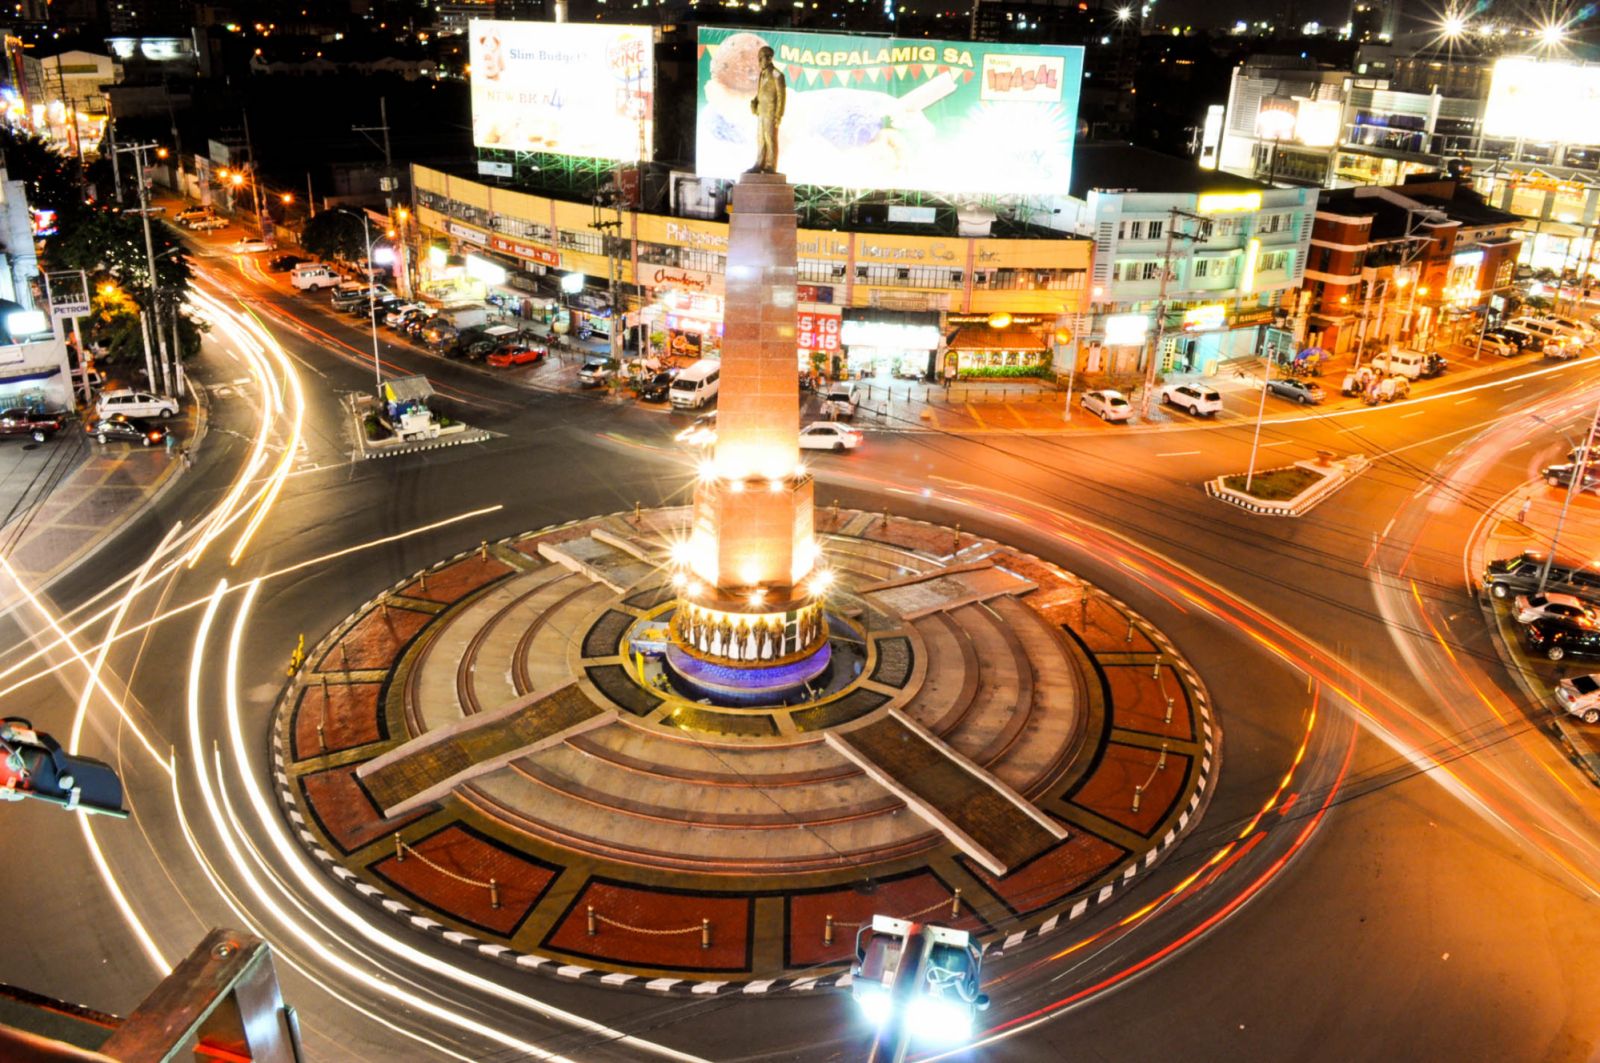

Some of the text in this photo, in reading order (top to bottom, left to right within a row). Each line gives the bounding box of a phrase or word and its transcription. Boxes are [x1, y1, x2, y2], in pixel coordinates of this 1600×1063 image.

[509, 48, 535, 60] Slim
[780, 44, 973, 67] MAGPALAMIG SA
[860, 239, 925, 260] Insurance
[54, 305, 89, 314] PETRON
[817, 334, 838, 349] 15
